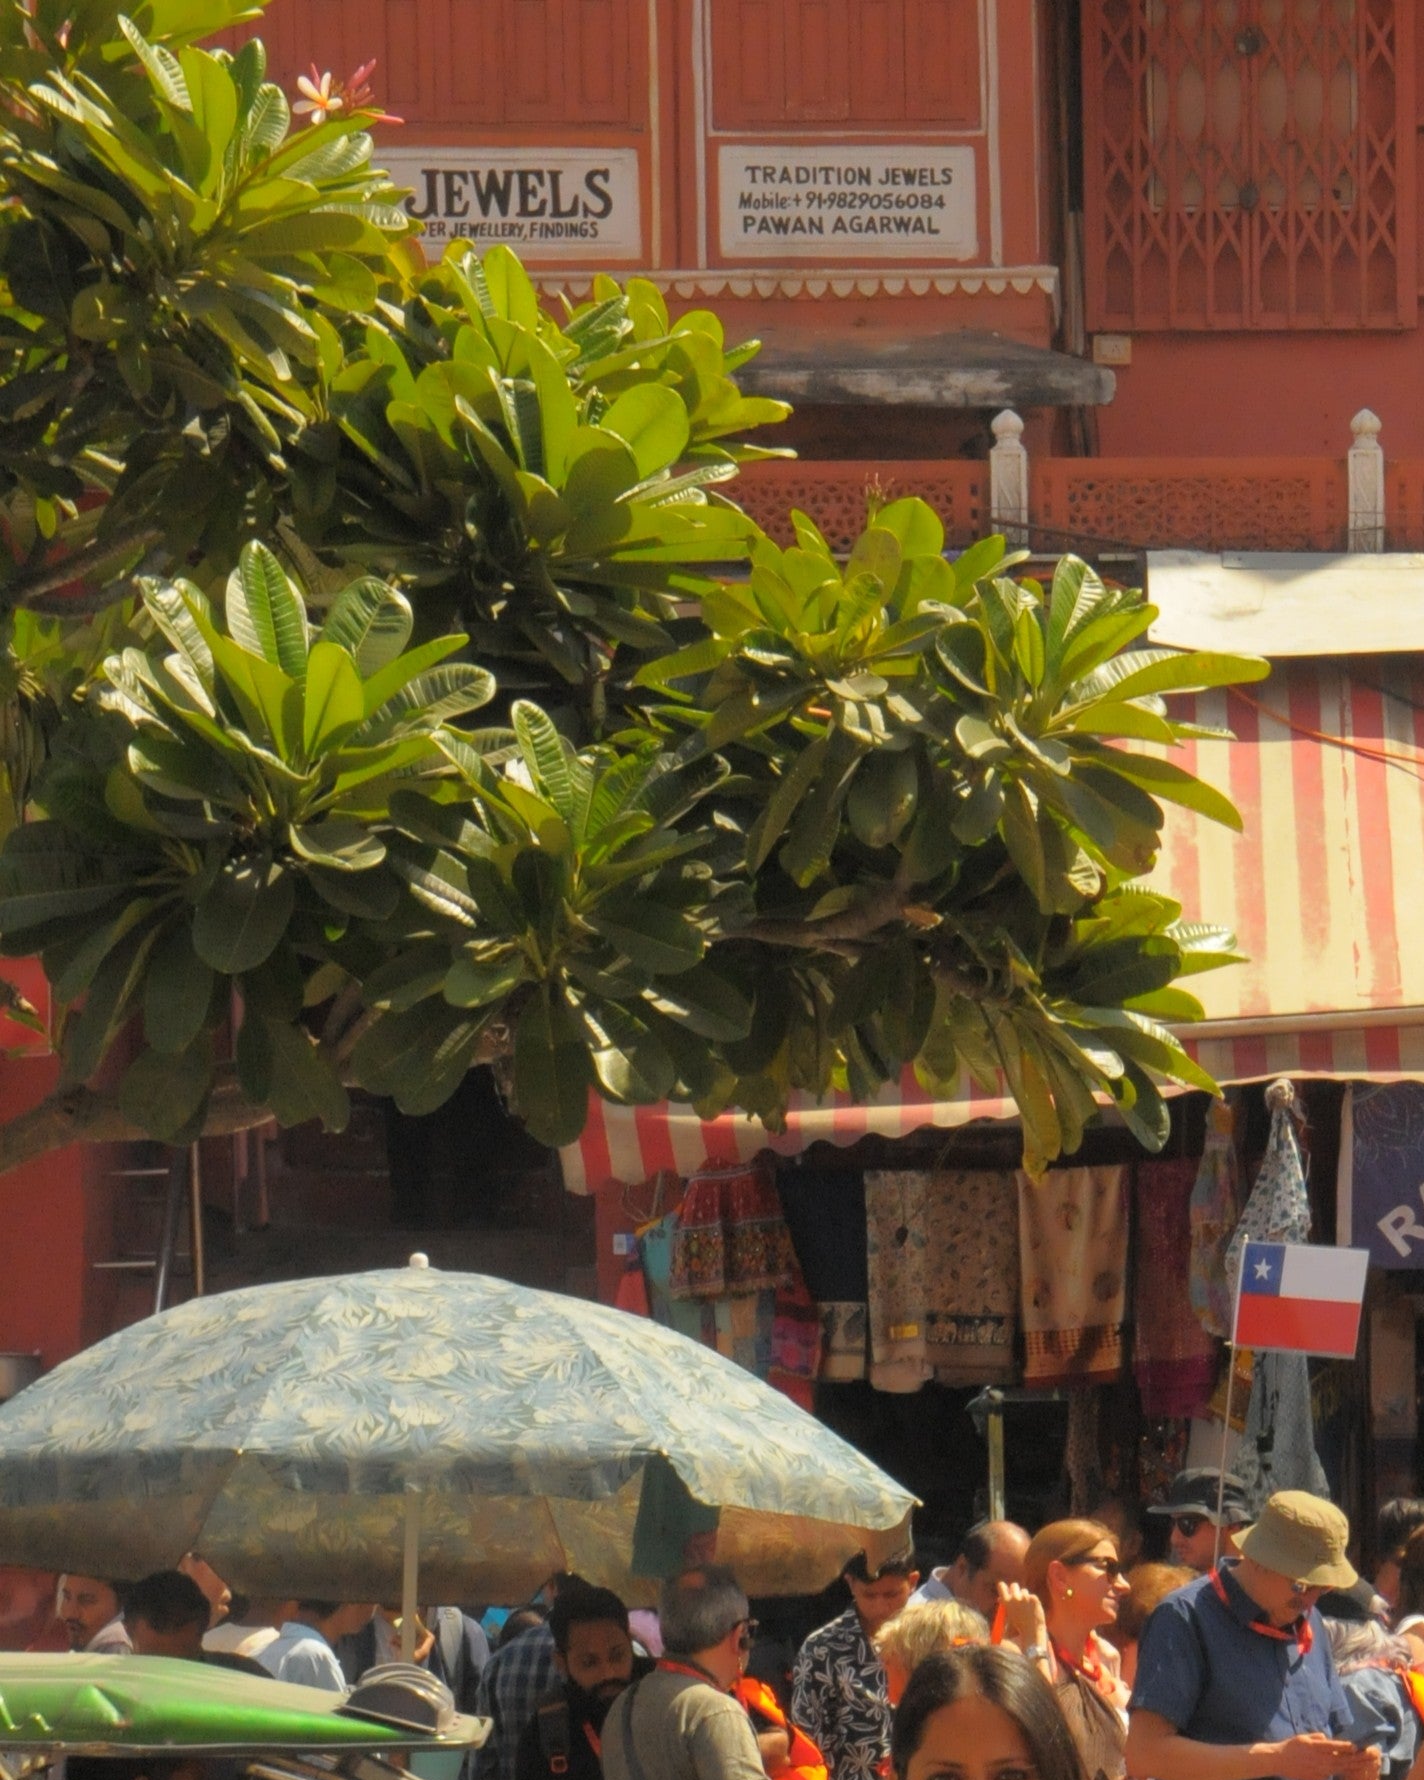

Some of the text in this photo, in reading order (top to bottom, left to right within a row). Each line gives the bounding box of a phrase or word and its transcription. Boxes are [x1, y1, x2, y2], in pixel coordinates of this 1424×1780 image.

[744, 165, 953, 188] TRADITION JEWELS
[404, 168, 613, 219] JEWELS
[743, 215, 940, 237] PAWAN AGARWAL
